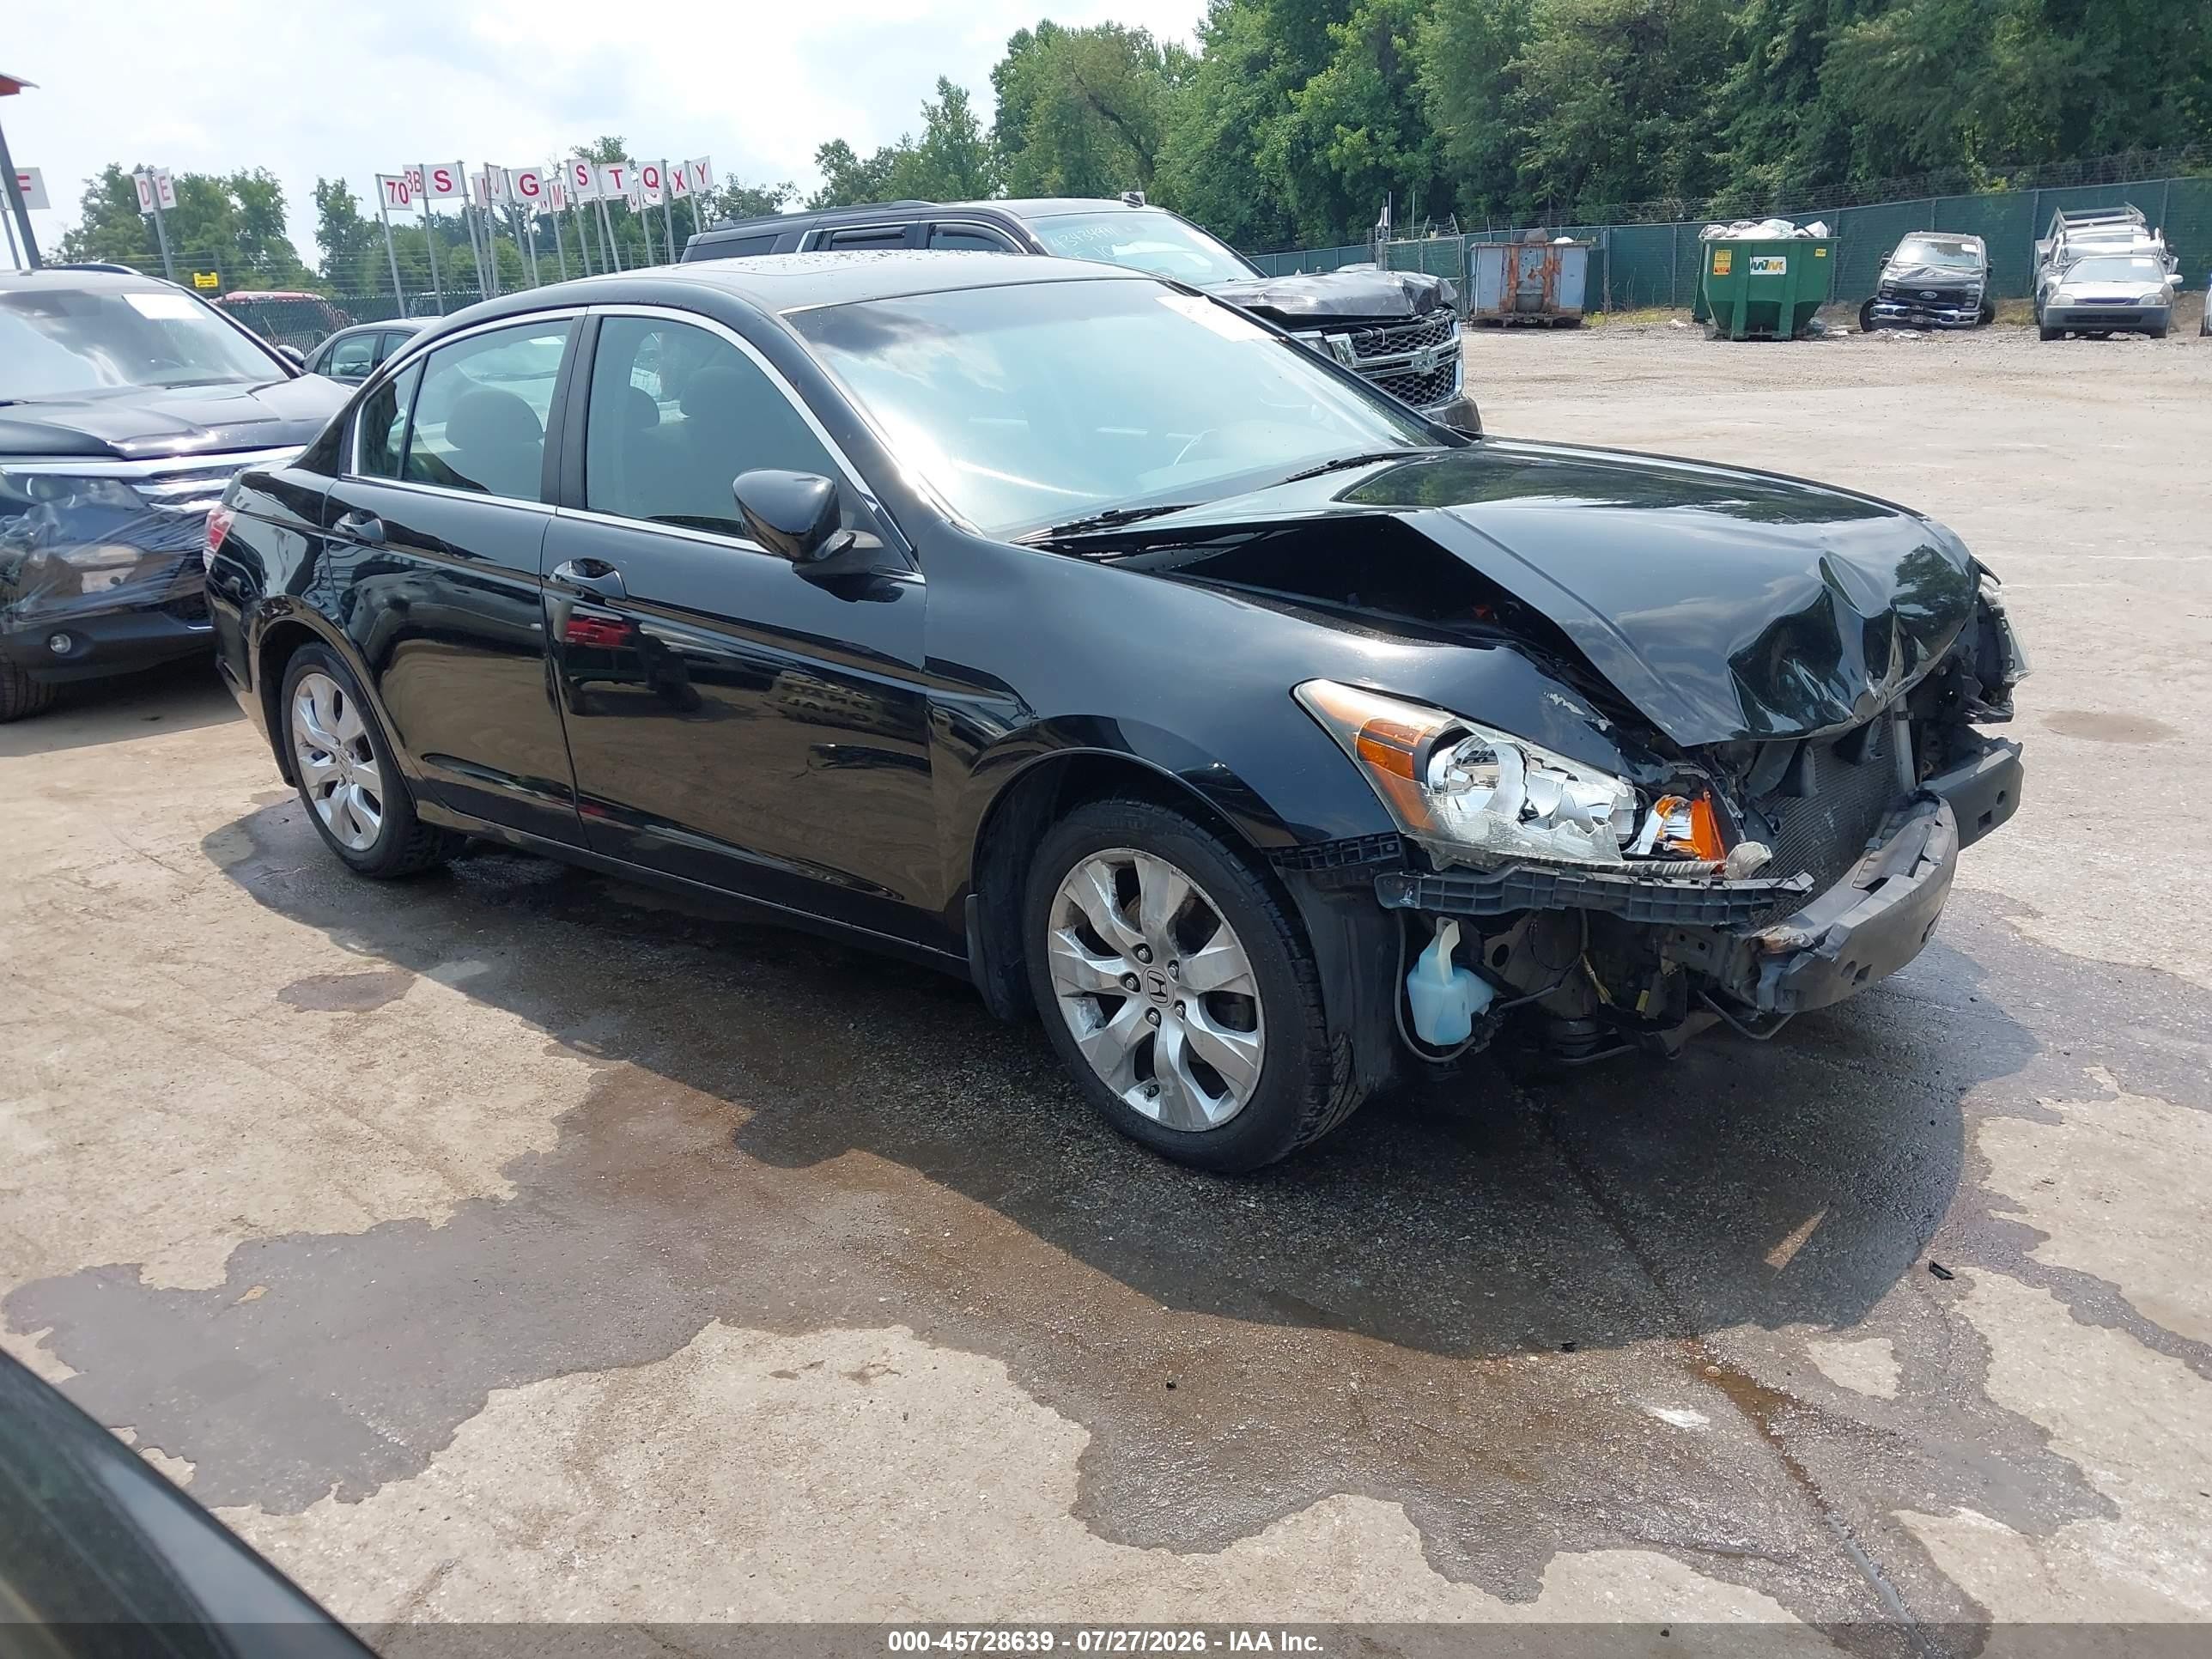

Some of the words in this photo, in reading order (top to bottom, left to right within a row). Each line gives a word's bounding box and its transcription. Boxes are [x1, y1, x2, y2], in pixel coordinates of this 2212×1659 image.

[434, 170, 453, 192] S
[575, 164, 589, 186] S
[609, 169, 623, 190] T
[642, 167, 659, 189] Q
[672, 170, 686, 191] X
[696, 162, 707, 185] Y
[139, 179, 151, 206] D
[158, 175, 171, 201] E
[386, 181, 409, 204] 70
[519, 173, 540, 197] G
[552, 184, 563, 206] M
